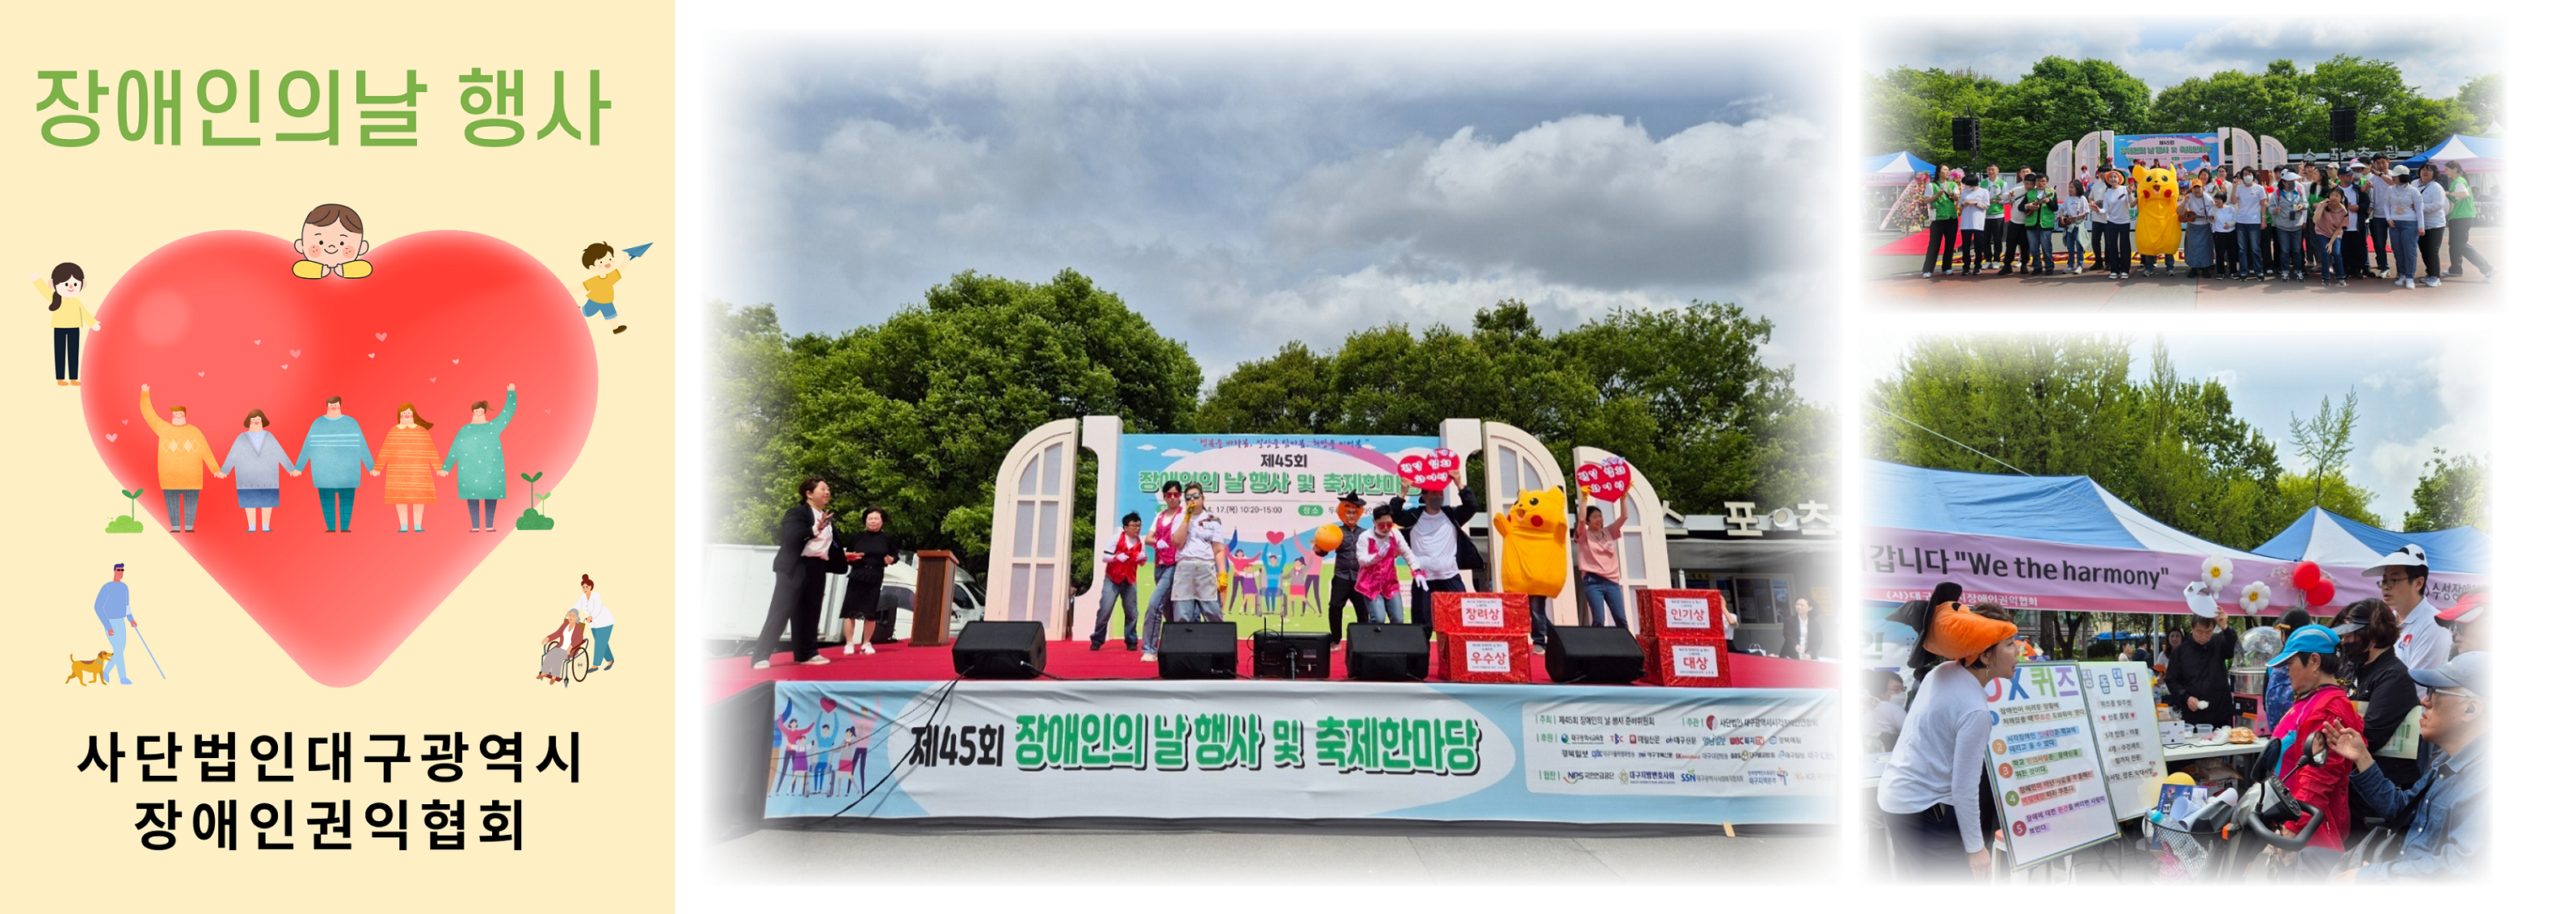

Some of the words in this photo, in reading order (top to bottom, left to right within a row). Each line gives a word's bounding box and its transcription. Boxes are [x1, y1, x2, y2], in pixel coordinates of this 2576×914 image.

[1261, 454, 1307, 468] 제45회
[1224, 471, 1245, 493] 날
[1248, 471, 1291, 494] 행사
[1297, 474, 1315, 494] 및
[2014, 557, 2057, 579] the
[1466, 608, 1500, 621] 장려상
[1671, 609, 1705, 621] 인기상
[1471, 651, 1506, 665] 우수상
[1683, 657, 1708, 671] 대상
[2030, 667, 2079, 697] 퀴즈
[1559, 715, 1579, 726] 제45회
[1580, 716, 1604, 727] 장애인의
[909, 724, 1004, 768] 제45회
[1016, 714, 1147, 770] 장애인의
[1154, 714, 1190, 771] 날
[1194, 714, 1265, 770] 행사
[1273, 718, 1305, 768] 및
[1315, 716, 1481, 775] 축제한마당
[1682, 773, 1696, 782] SSN
